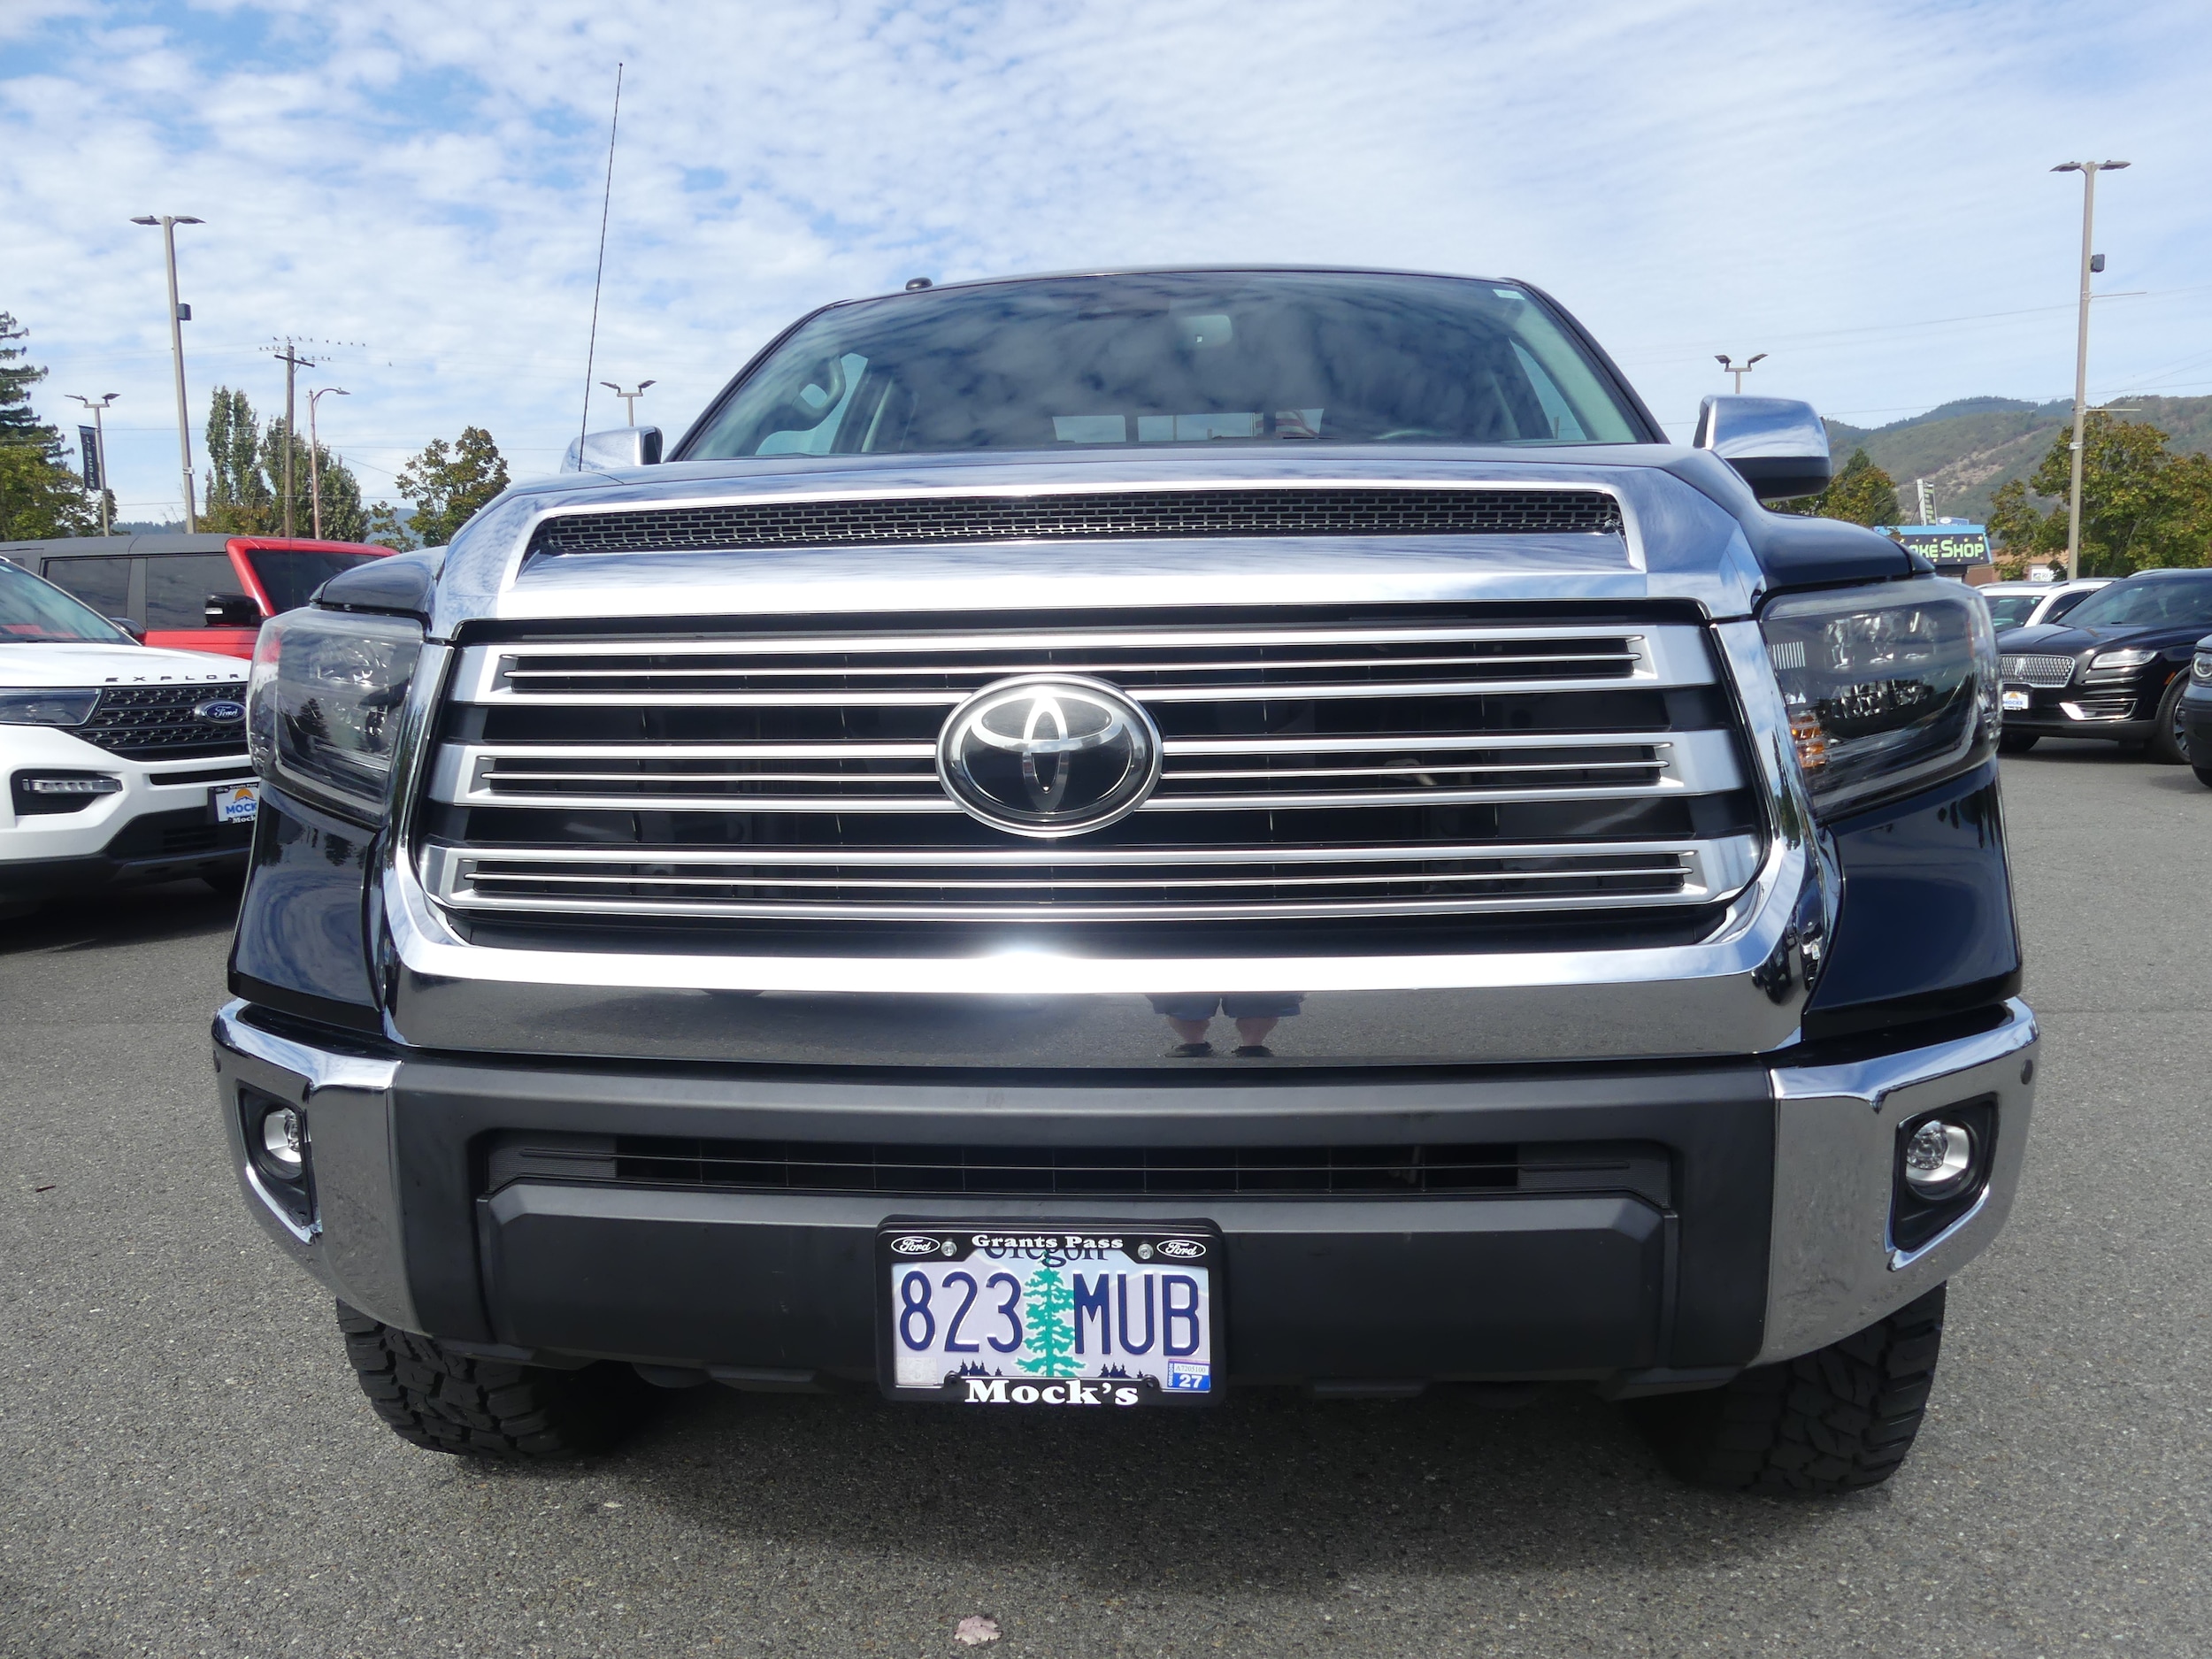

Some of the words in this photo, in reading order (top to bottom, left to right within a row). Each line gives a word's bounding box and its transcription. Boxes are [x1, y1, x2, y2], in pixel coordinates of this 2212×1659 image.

[1909, 544, 1939, 558] OKE
[105, 673, 239, 682] EXPLOR
[226, 803, 257, 814] MOCK
[898, 1238, 933, 1253] Ford
[972, 1234, 1057, 1248] Grants
[1064, 1235, 1124, 1248] Pass
[1164, 1241, 1198, 1256] Ford
[899, 1271, 1023, 1352] 823
[1072, 1272, 1199, 1356] MUB
[1179, 1373, 1203, 1388] 27
[964, 1379, 1139, 1405] Mock's
